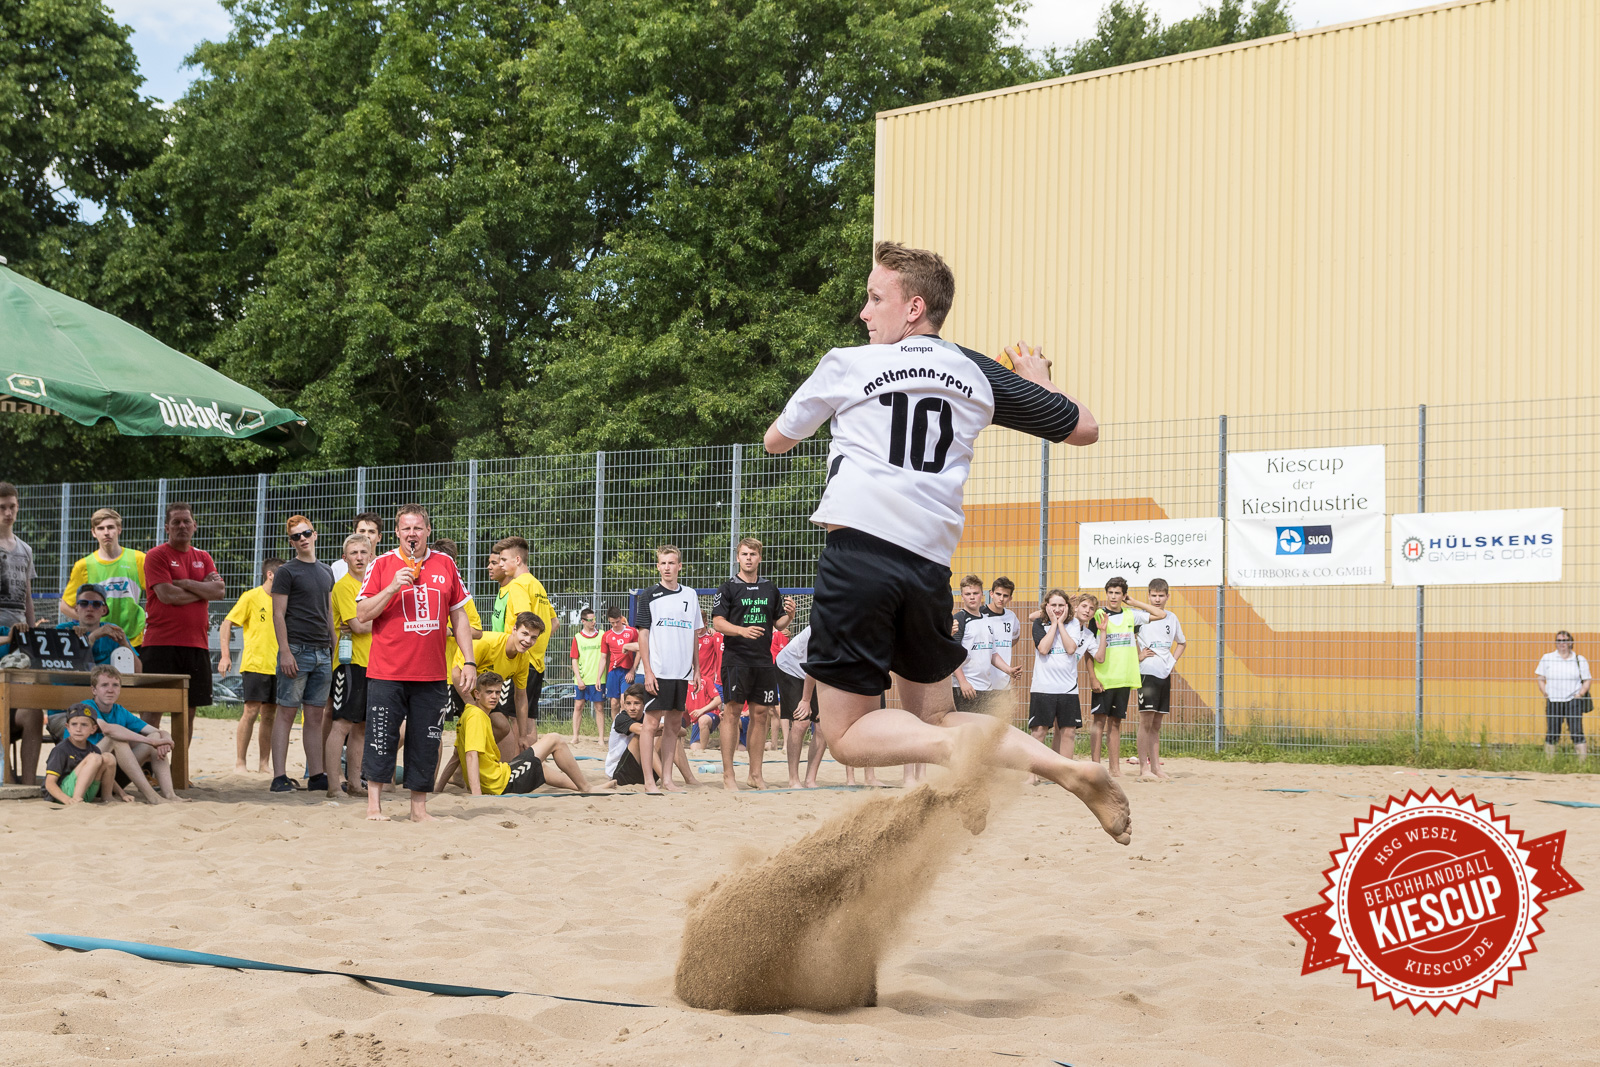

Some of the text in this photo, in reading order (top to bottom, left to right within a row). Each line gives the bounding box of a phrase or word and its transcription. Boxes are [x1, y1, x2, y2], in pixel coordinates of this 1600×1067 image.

[900, 345, 933, 354] Kempa
[863, 367, 973, 398] mettmann-sport
[150, 392, 235, 435] Diebels
[879, 391, 954, 474] 10
[1267, 457, 1344, 475] Kiescup
[1292, 479, 1315, 490] der
[1242, 493, 1368, 515] Kiesindustrie
[1093, 530, 1207, 545] Rheinkies-Baggerei
[1308, 535, 1330, 545] SUCO
[1429, 533, 1553, 549] HÜLSKENS
[1428, 551, 1477, 562] GMBH
[1483, 550, 1495, 560] &
[1088, 554, 1212, 574] Menting & Bresser
[431, 574, 446, 584] 70
[1237, 566, 1372, 579] SUHRBORG & CO. GMBH
[416, 586, 428, 618] XUXU
[683, 601, 688, 612] 7
[741, 597, 768, 606] Wir sind
[260, 614, 266, 623] 8
[1003, 622, 1011, 633] 13
[1165, 625, 1171, 635] 3
[19, 632, 27, 645] 1
[37, 636, 50, 655] 2
[60, 637, 74, 656] 2
[41, 659, 73, 669] JOOLA
[764, 690, 774, 703] 18
